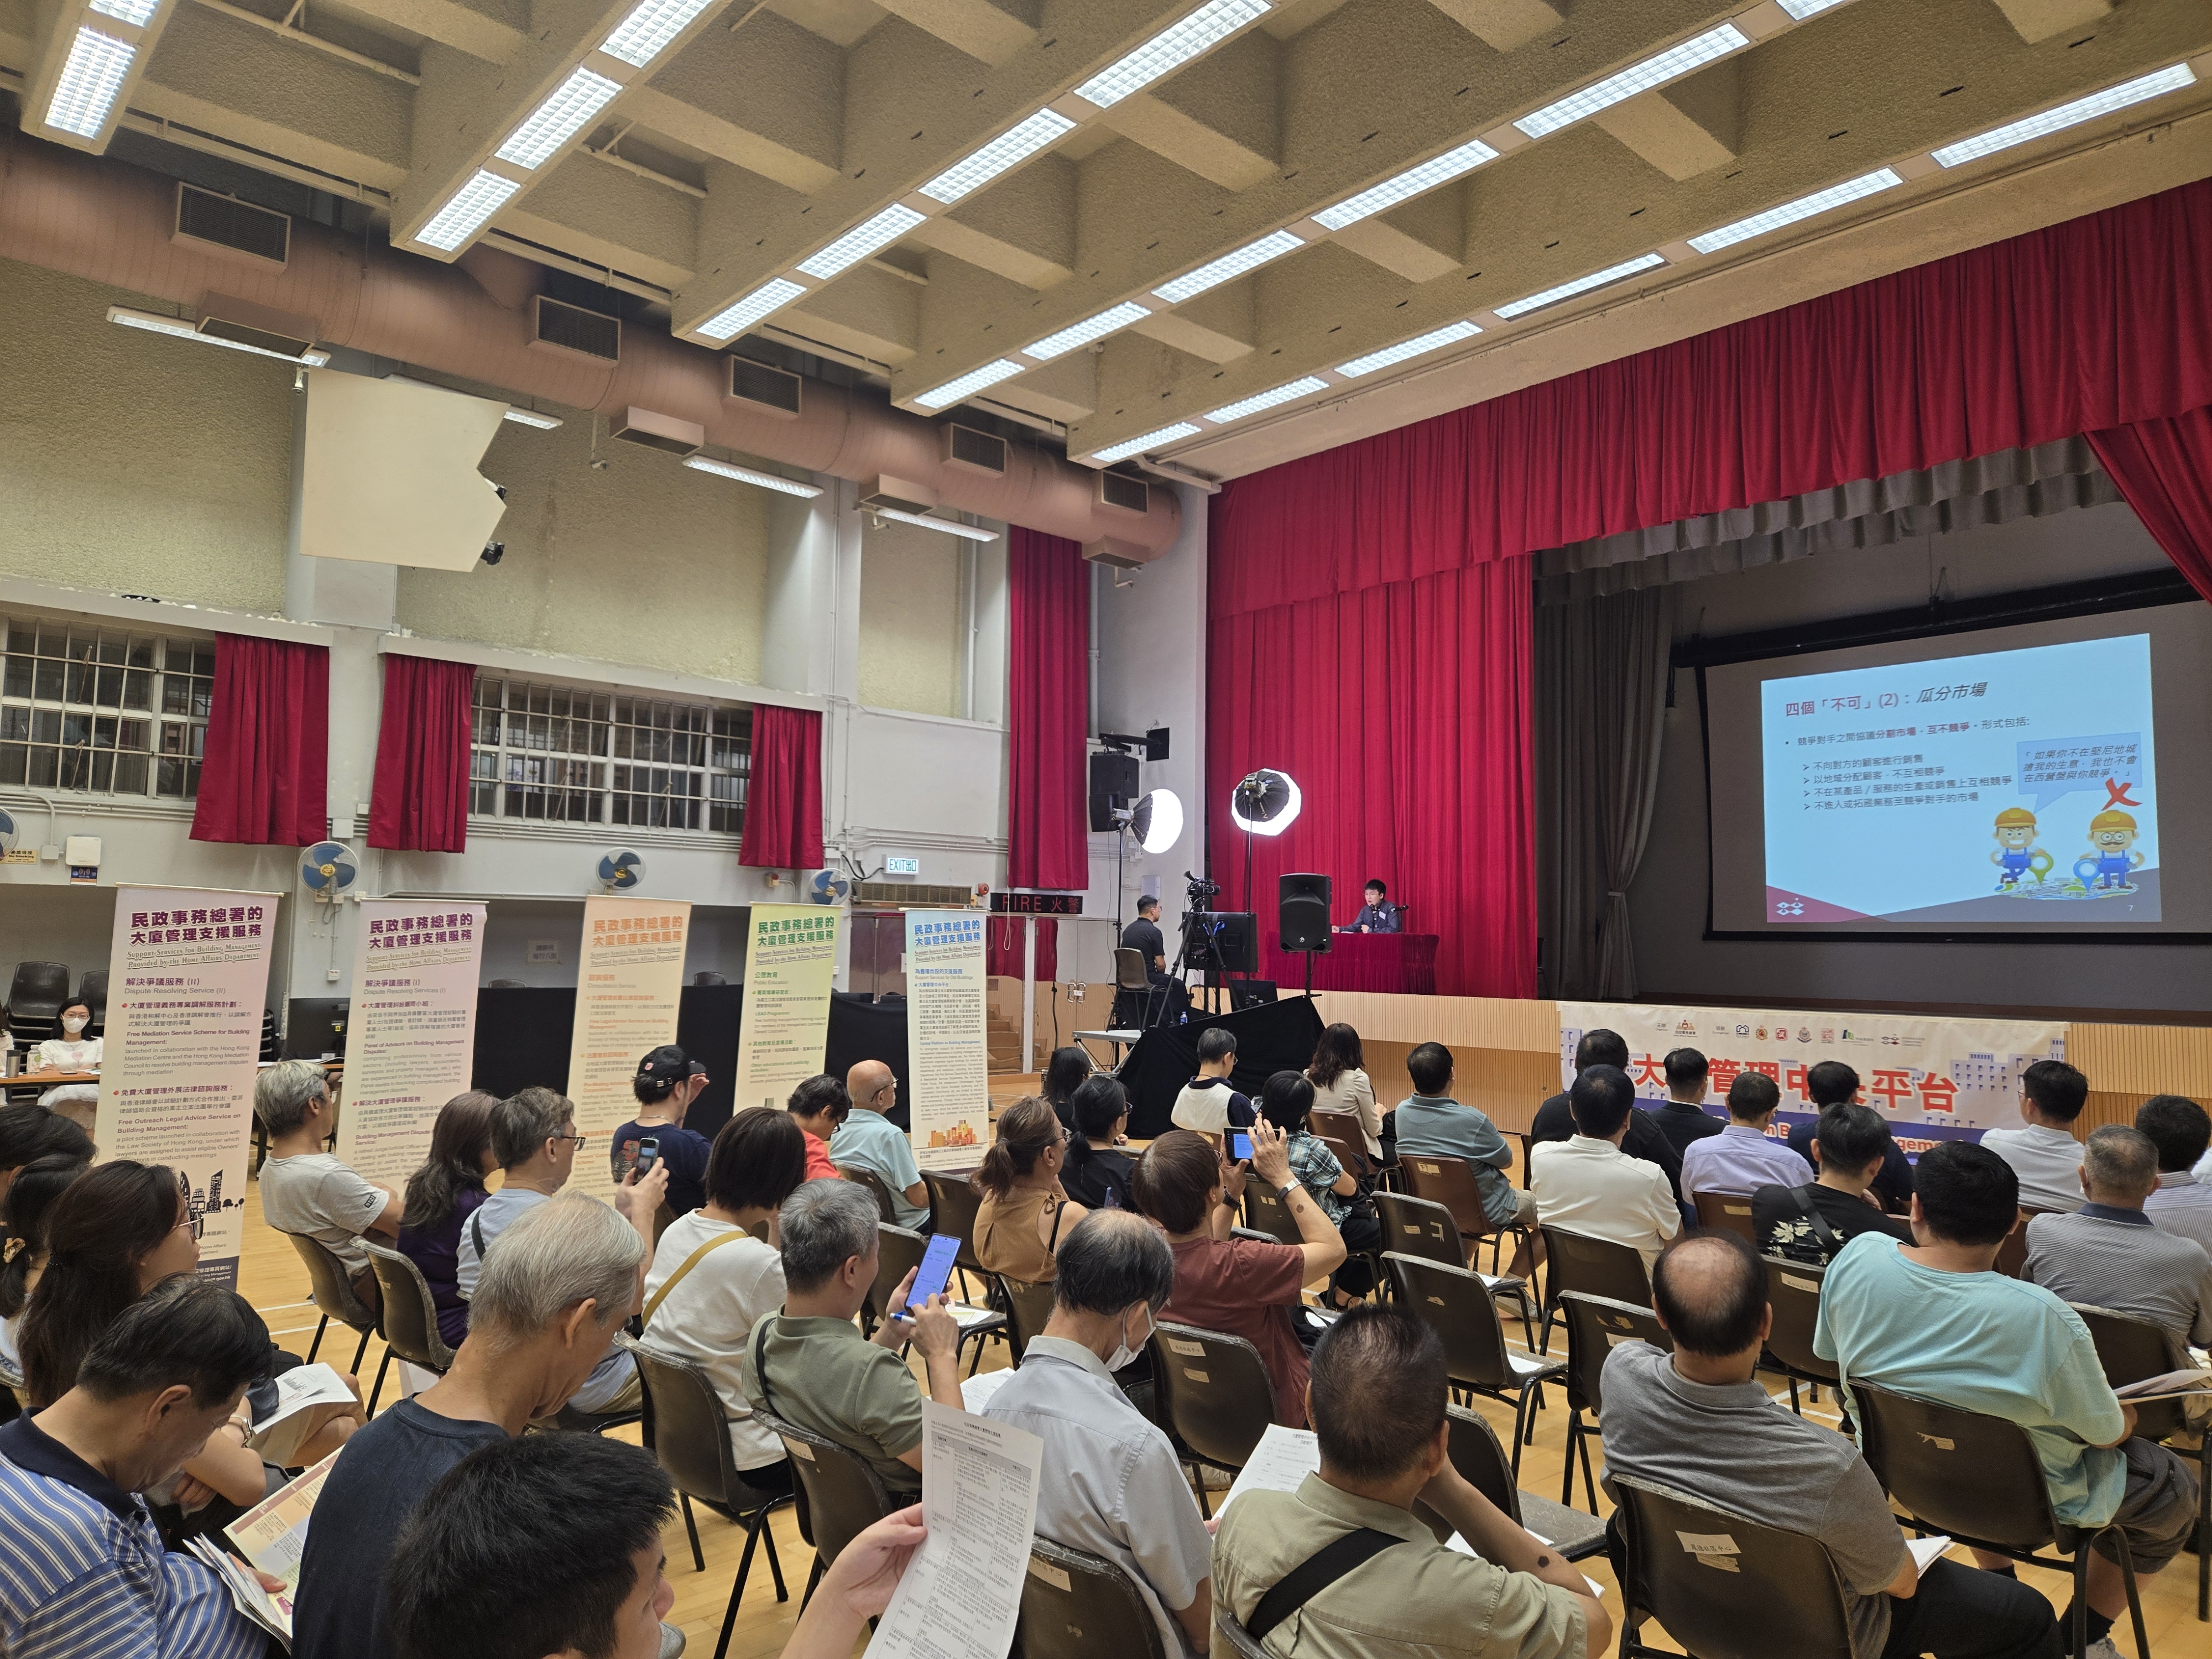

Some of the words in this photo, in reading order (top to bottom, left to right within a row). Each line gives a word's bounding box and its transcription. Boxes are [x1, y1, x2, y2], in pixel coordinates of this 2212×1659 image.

[889, 859, 906, 871] EXIT
[1002, 895, 1041, 911] FIRE
[1051, 896, 1078, 914] 火警
[131, 906, 263, 928] 民政事務總署的
[370, 913, 473, 935] 民政事務總署的
[594, 916, 682, 932] 民政事務總署的
[758, 916, 834, 933] 民政事務總署的
[130, 924, 262, 945] 大廈管理支援服務
[914, 920, 980, 935] 民政事務總署的
[369, 930, 472, 950] 大廈管理支援服務
[593, 931, 682, 946] 大廈管理支援服務
[758, 930, 833, 946] 大廈管理支援服務
[915, 932, 980, 946] 大廈管理支援服務
[126, 978, 184, 986] 解決爭議服務
